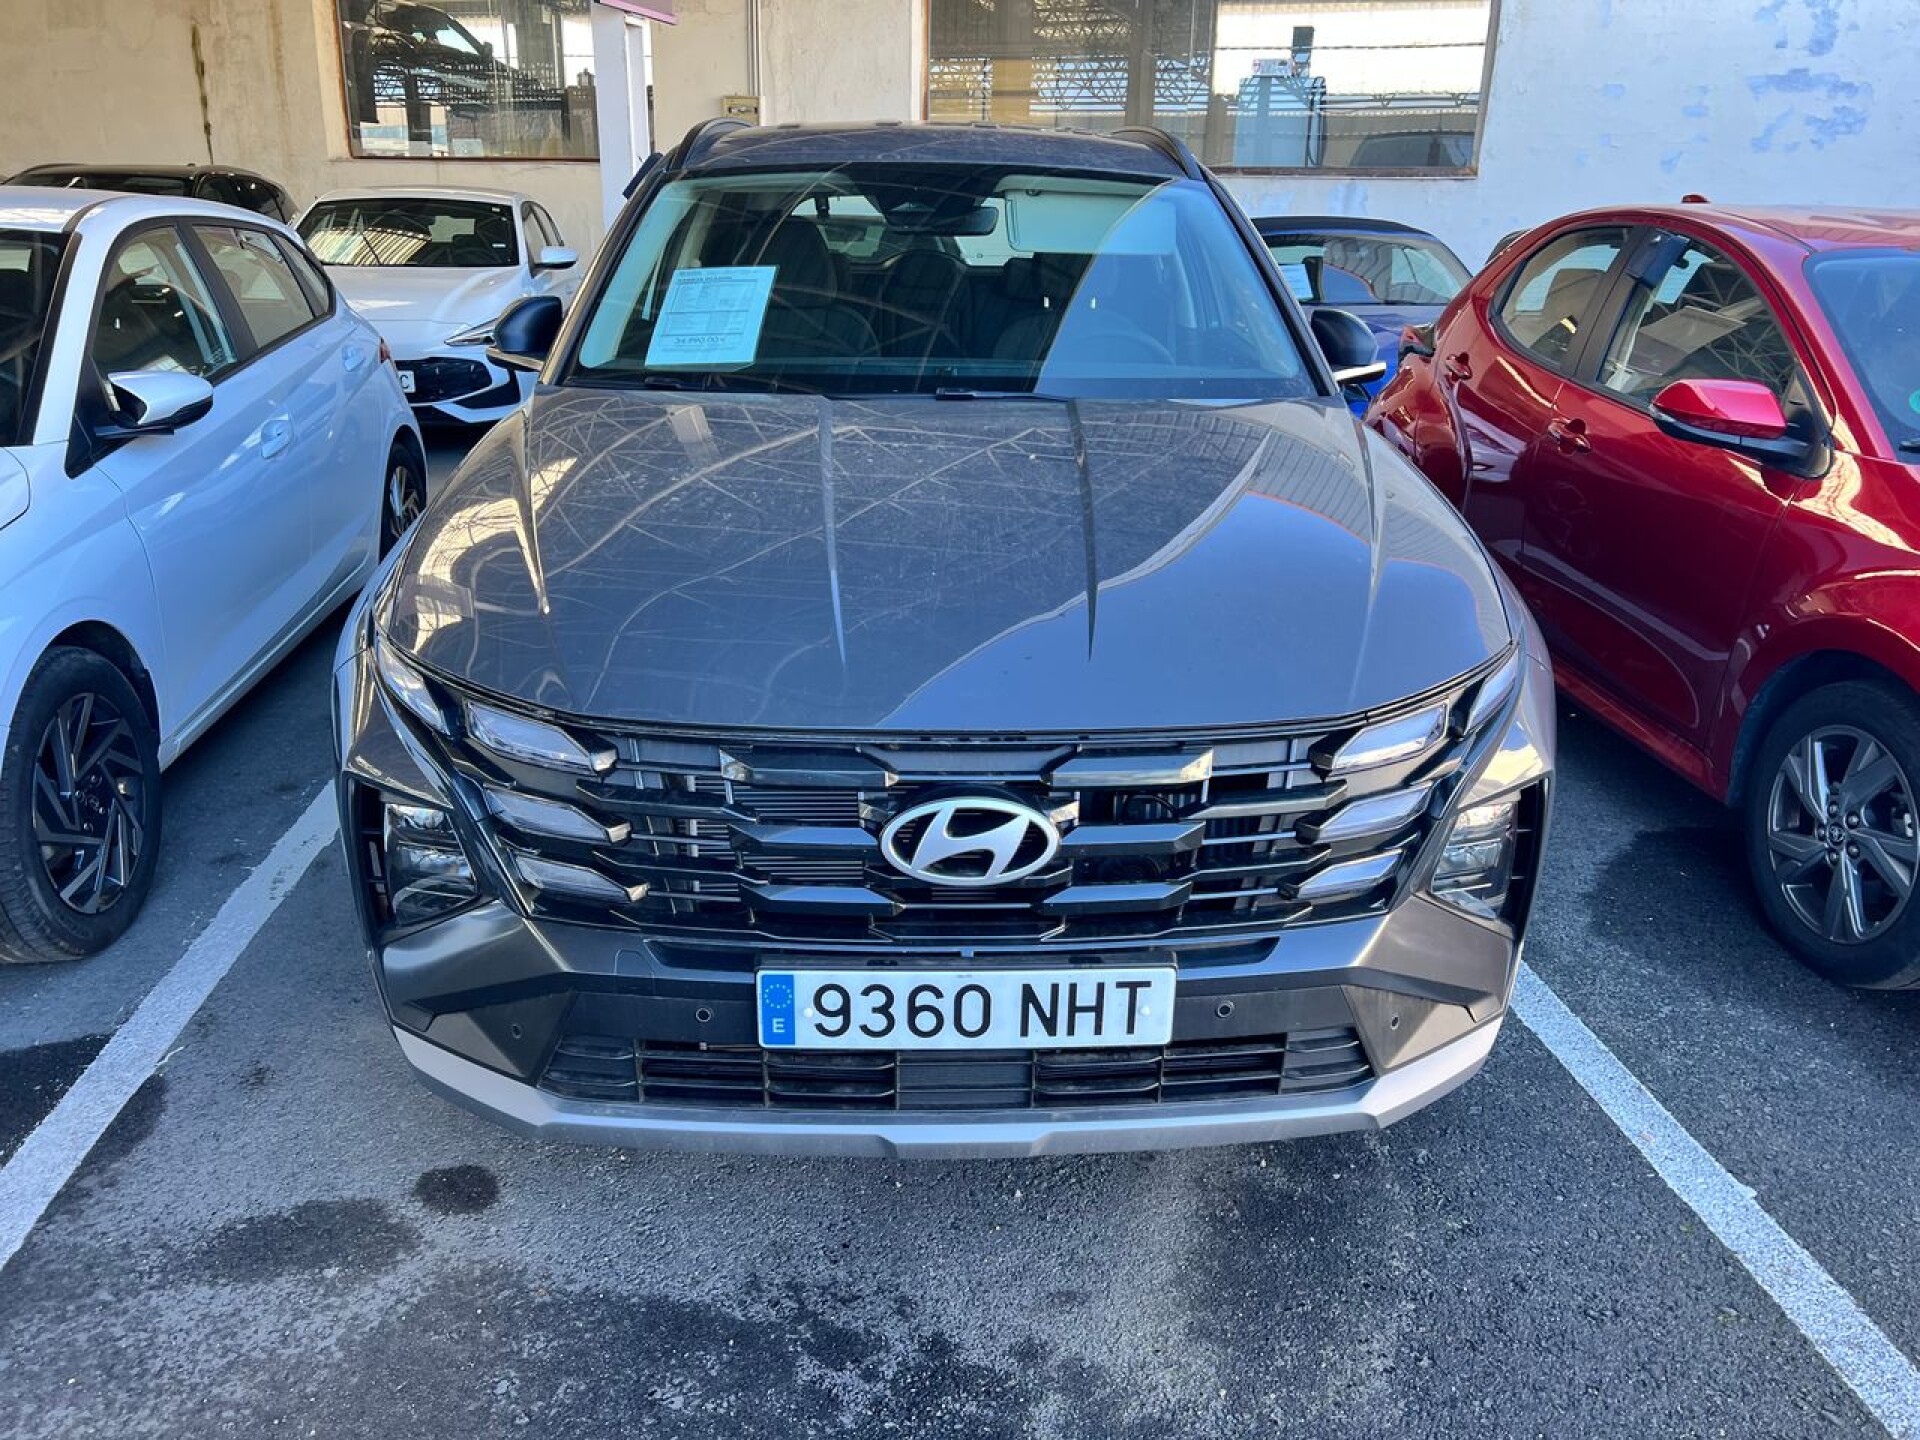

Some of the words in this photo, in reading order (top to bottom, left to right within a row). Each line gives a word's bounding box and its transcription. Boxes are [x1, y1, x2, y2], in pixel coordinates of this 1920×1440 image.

[400, 374, 409, 389] C
[813, 983, 991, 1038] 9360
[1020, 980, 1152, 1037] NHT
[772, 1018, 785, 1033] E
